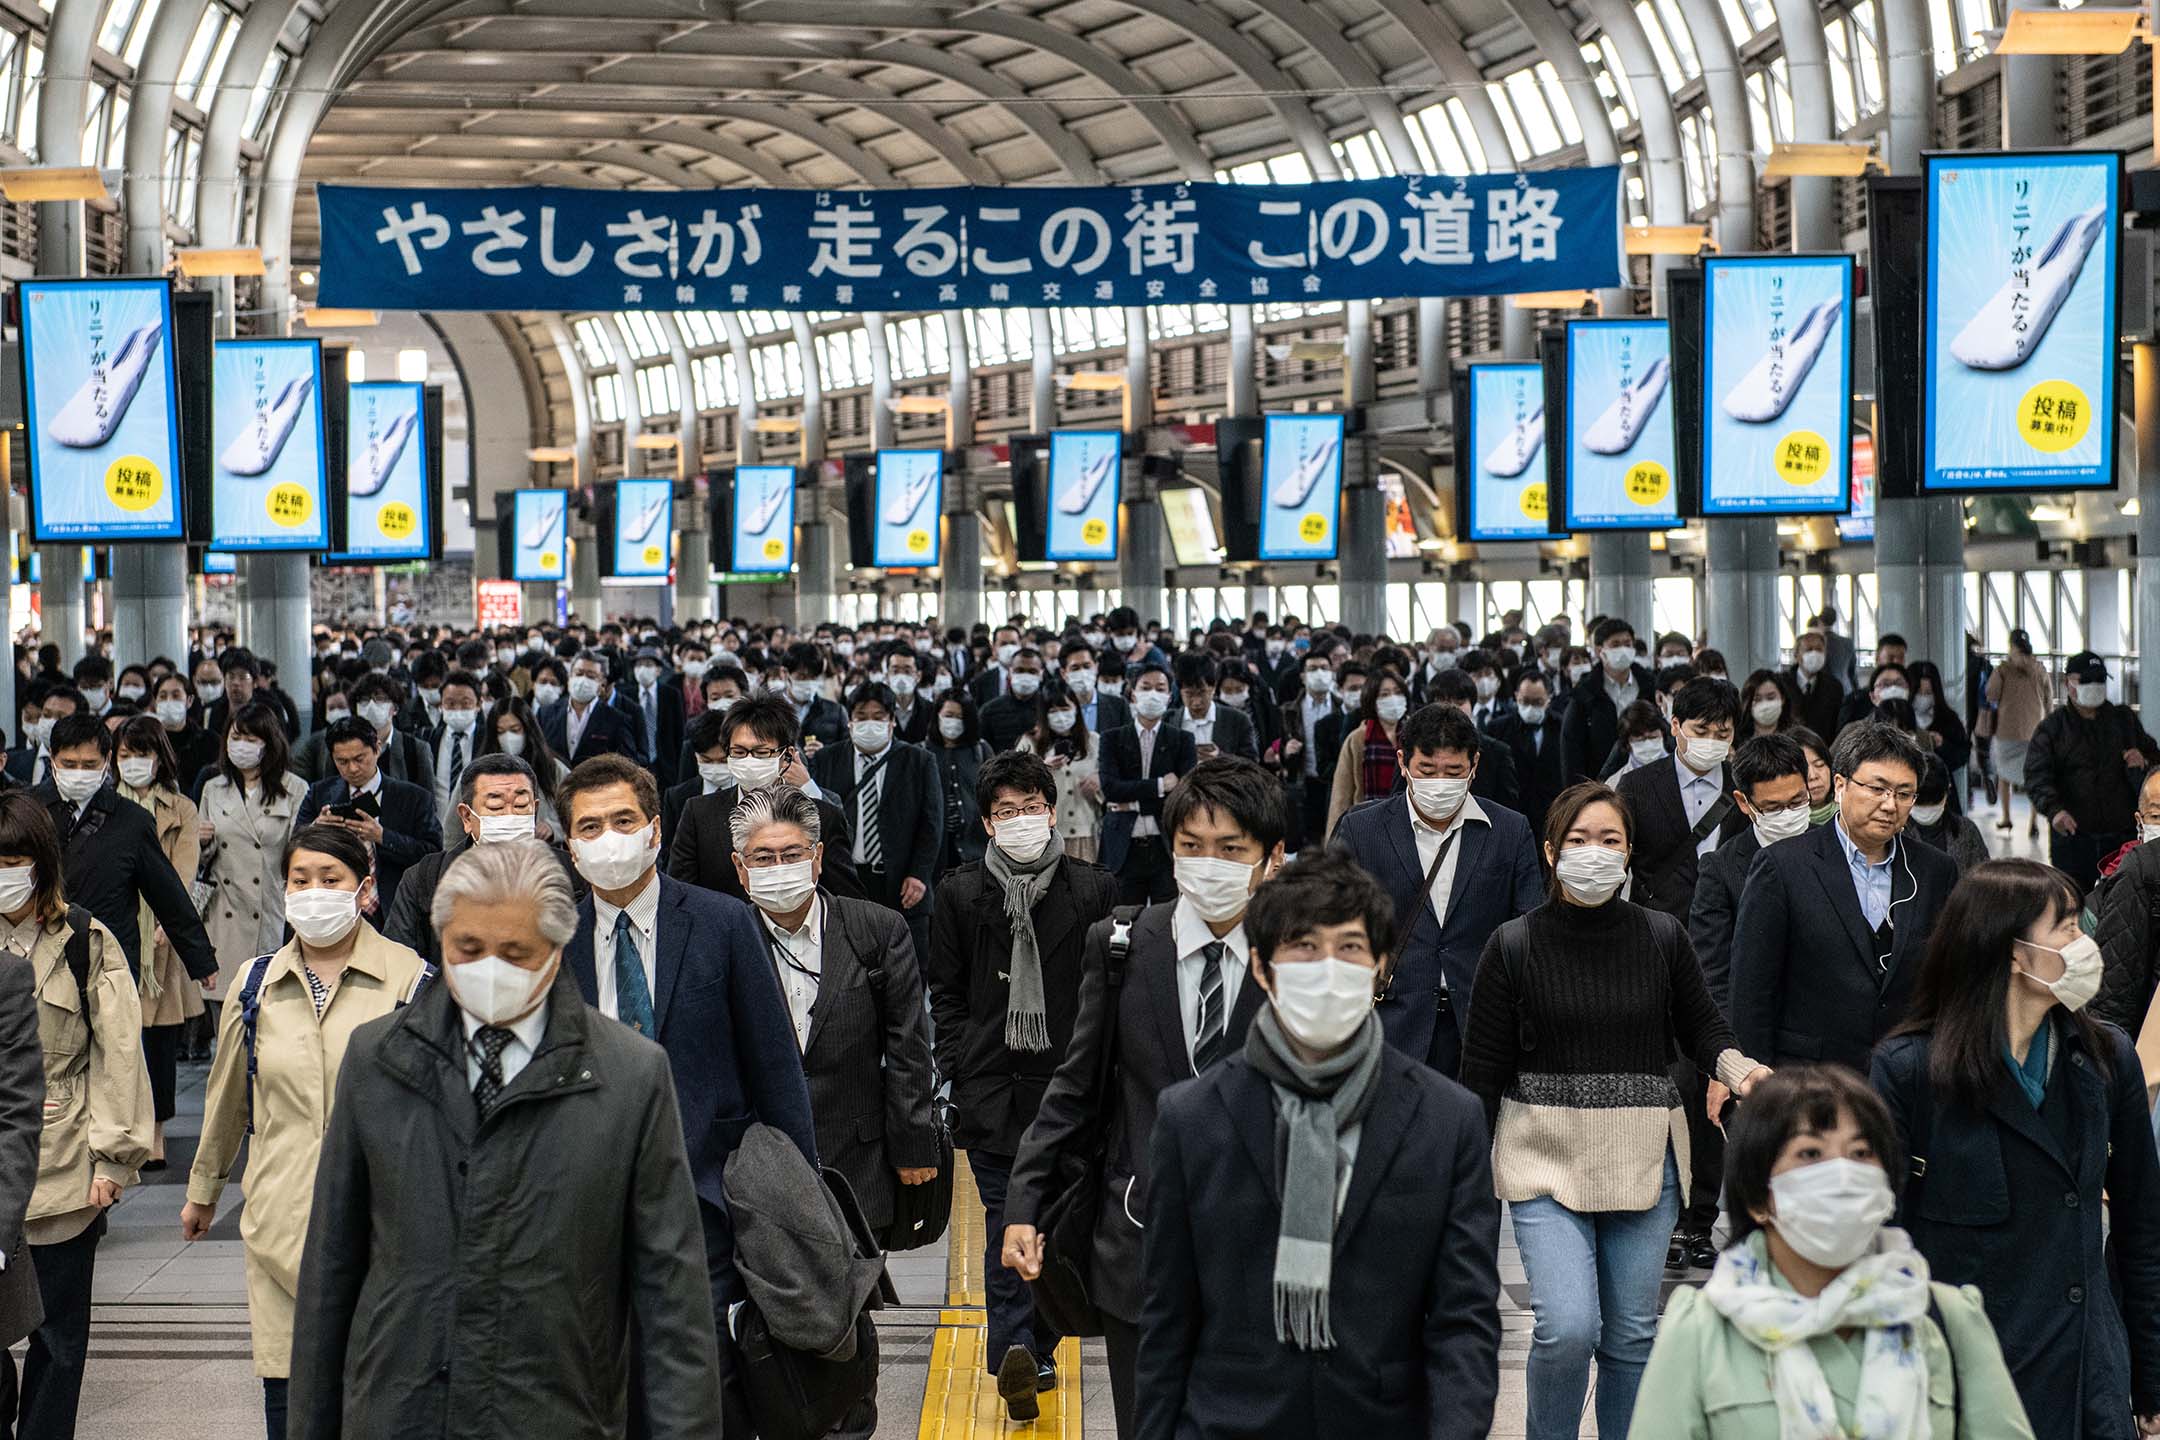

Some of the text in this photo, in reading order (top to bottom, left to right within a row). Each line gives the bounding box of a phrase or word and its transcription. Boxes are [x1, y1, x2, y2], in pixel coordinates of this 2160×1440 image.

[375, 187, 1564, 279] やさしさが 走るこの街 この道路
[2032, 395, 2078, 421] 投稿
[117, 467, 152, 487] 投稿
